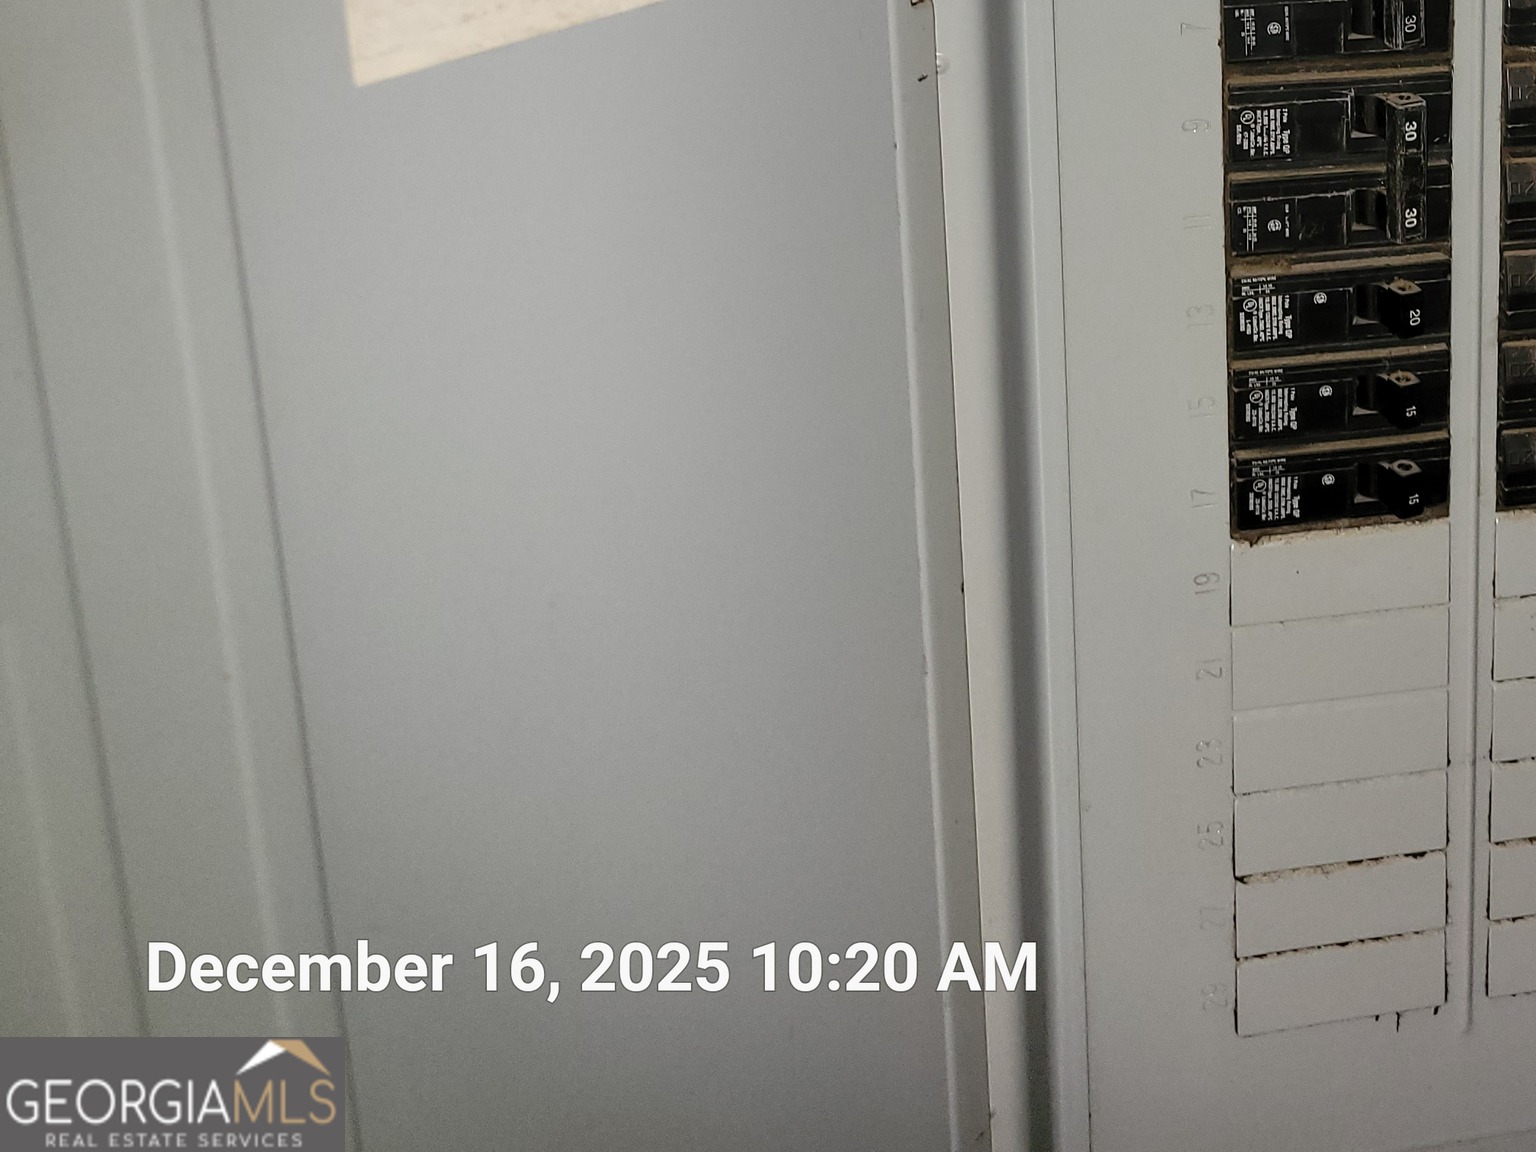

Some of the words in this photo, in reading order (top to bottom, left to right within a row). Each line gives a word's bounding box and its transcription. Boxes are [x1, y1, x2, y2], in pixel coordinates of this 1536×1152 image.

[1180, 22, 1210, 37] 7
[1405, 15, 1417, 33] 30
[1181, 119, 1211, 134] 9
[1404, 121, 1417, 142] 30
[1405, 208, 1417, 228] 30
[1410, 309, 1420, 326] 20
[1405, 405, 1416, 417] 15
[1190, 488, 1218, 509] 17
[1409, 493, 1419, 505] 15
[1193, 572, 1220, 595] 19
[1195, 658, 1223, 680] 21
[1196, 739, 1223, 769] 23
[1197, 820, 1223, 850] 25
